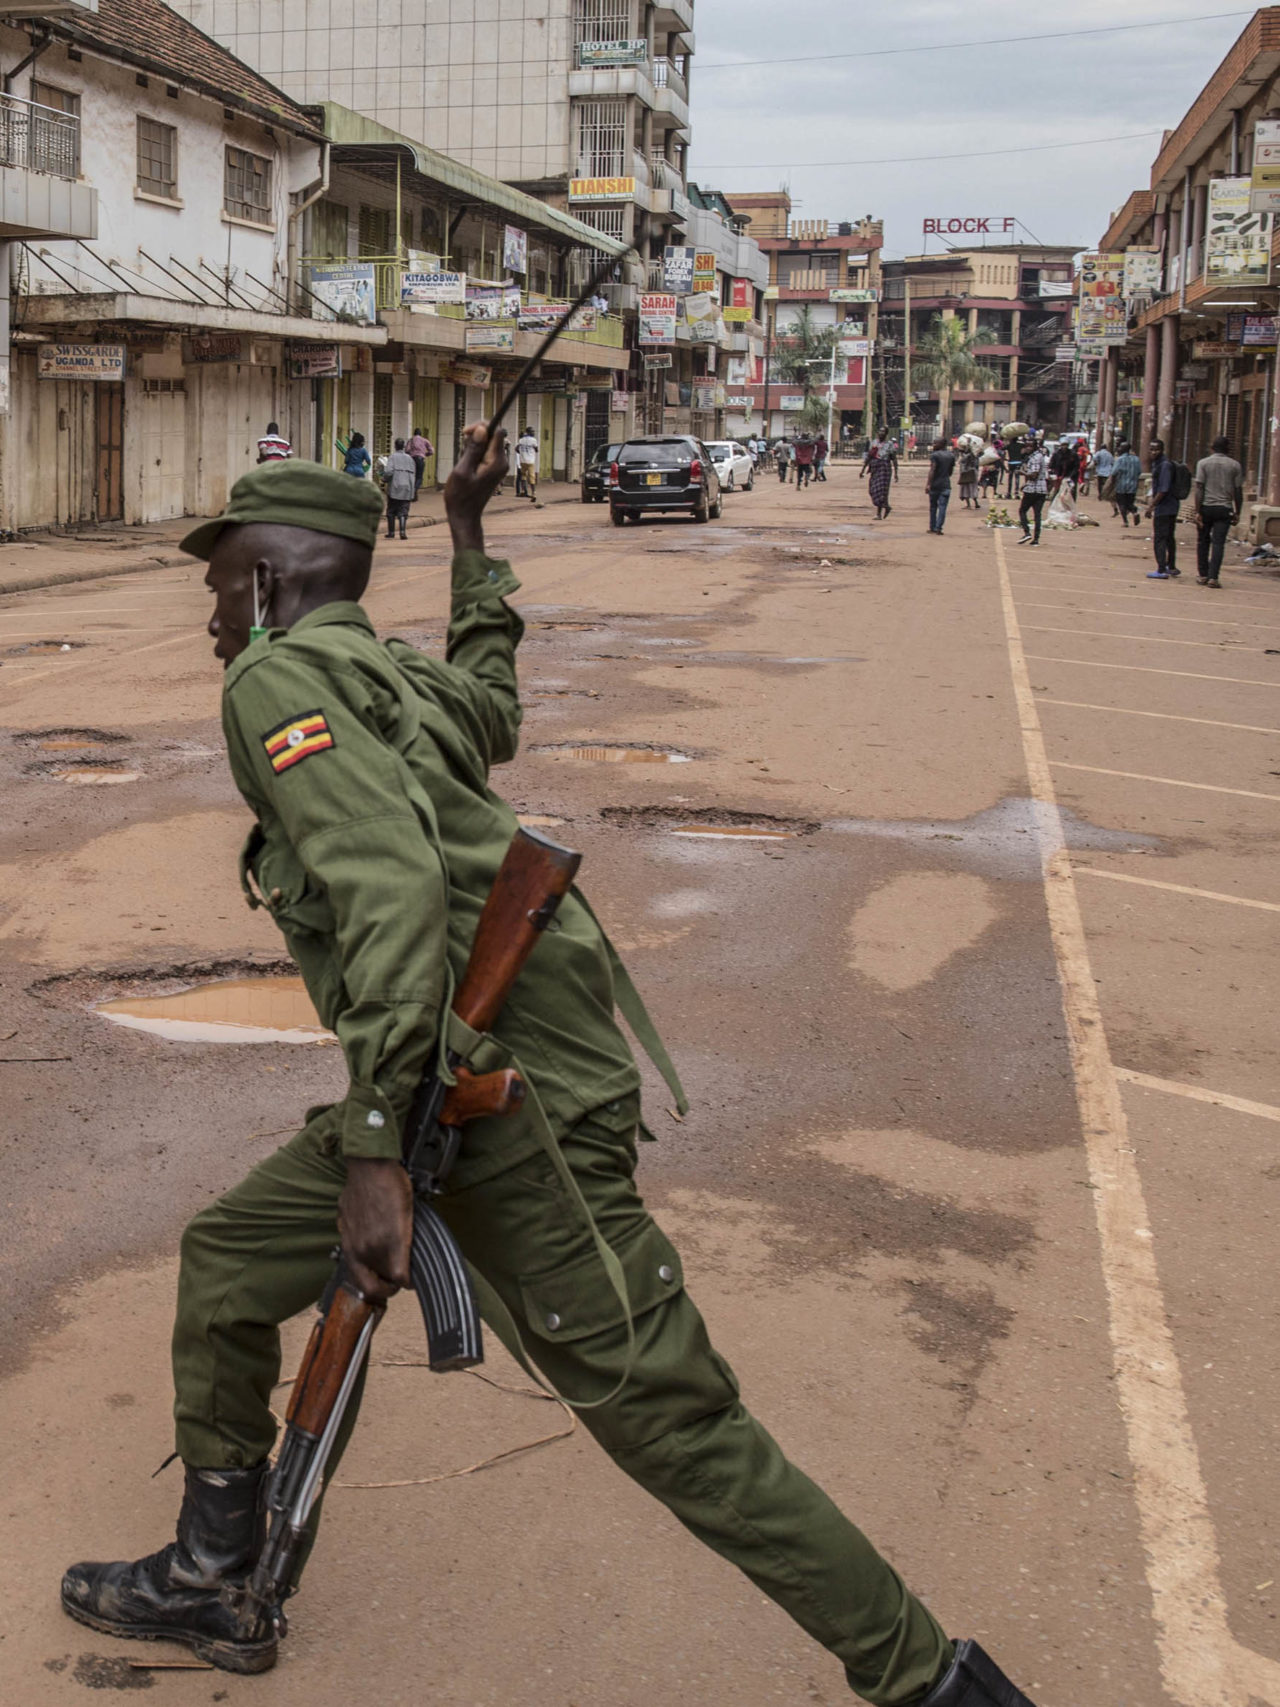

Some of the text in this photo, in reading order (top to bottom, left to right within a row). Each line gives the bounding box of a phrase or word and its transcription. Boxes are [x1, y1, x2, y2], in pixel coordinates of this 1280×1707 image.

[581, 41, 623, 51] HOTEL
[571, 178, 633, 195] TIANSHI
[923, 217, 1015, 233] BLOCK F
[405, 273, 460, 282] KITAGOBWA
[641, 296, 676, 309] SARAH
[56, 345, 121, 357] SWISSGARDE
[56, 357, 121, 367] UGANDA LTD
